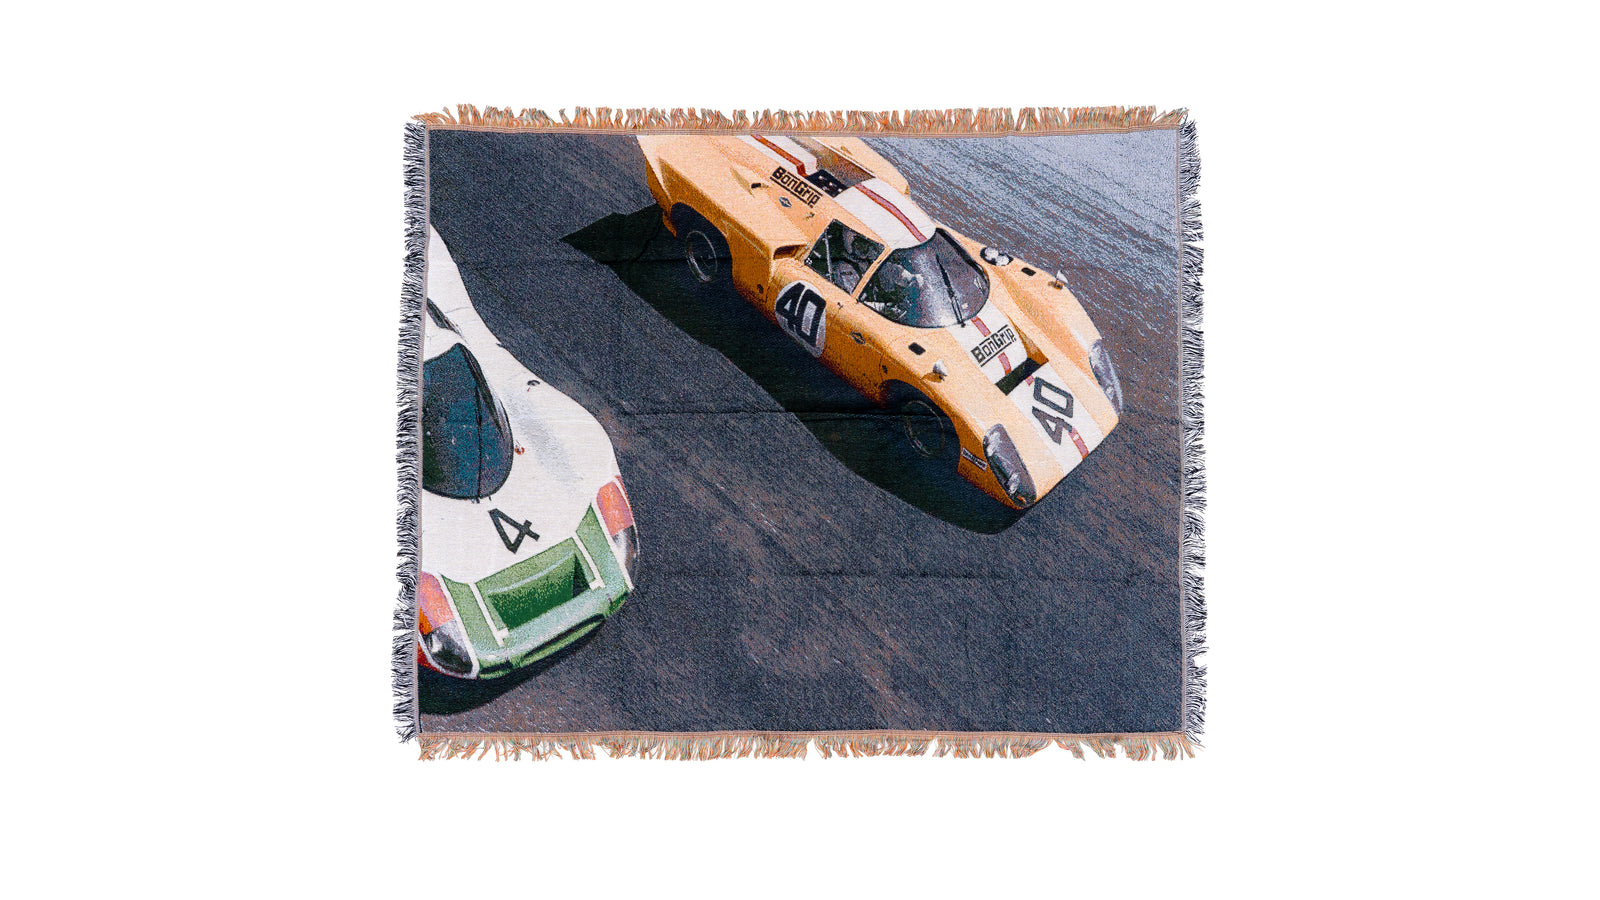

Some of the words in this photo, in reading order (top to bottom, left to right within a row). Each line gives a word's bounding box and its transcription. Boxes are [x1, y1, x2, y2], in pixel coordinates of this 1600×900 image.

[771, 166, 821, 208] BonGrip
[775, 282, 827, 348] 40
[971, 325, 1016, 365] BonGrip
[1031, 376, 1074, 446] 40
[488, 508, 541, 554] 4
